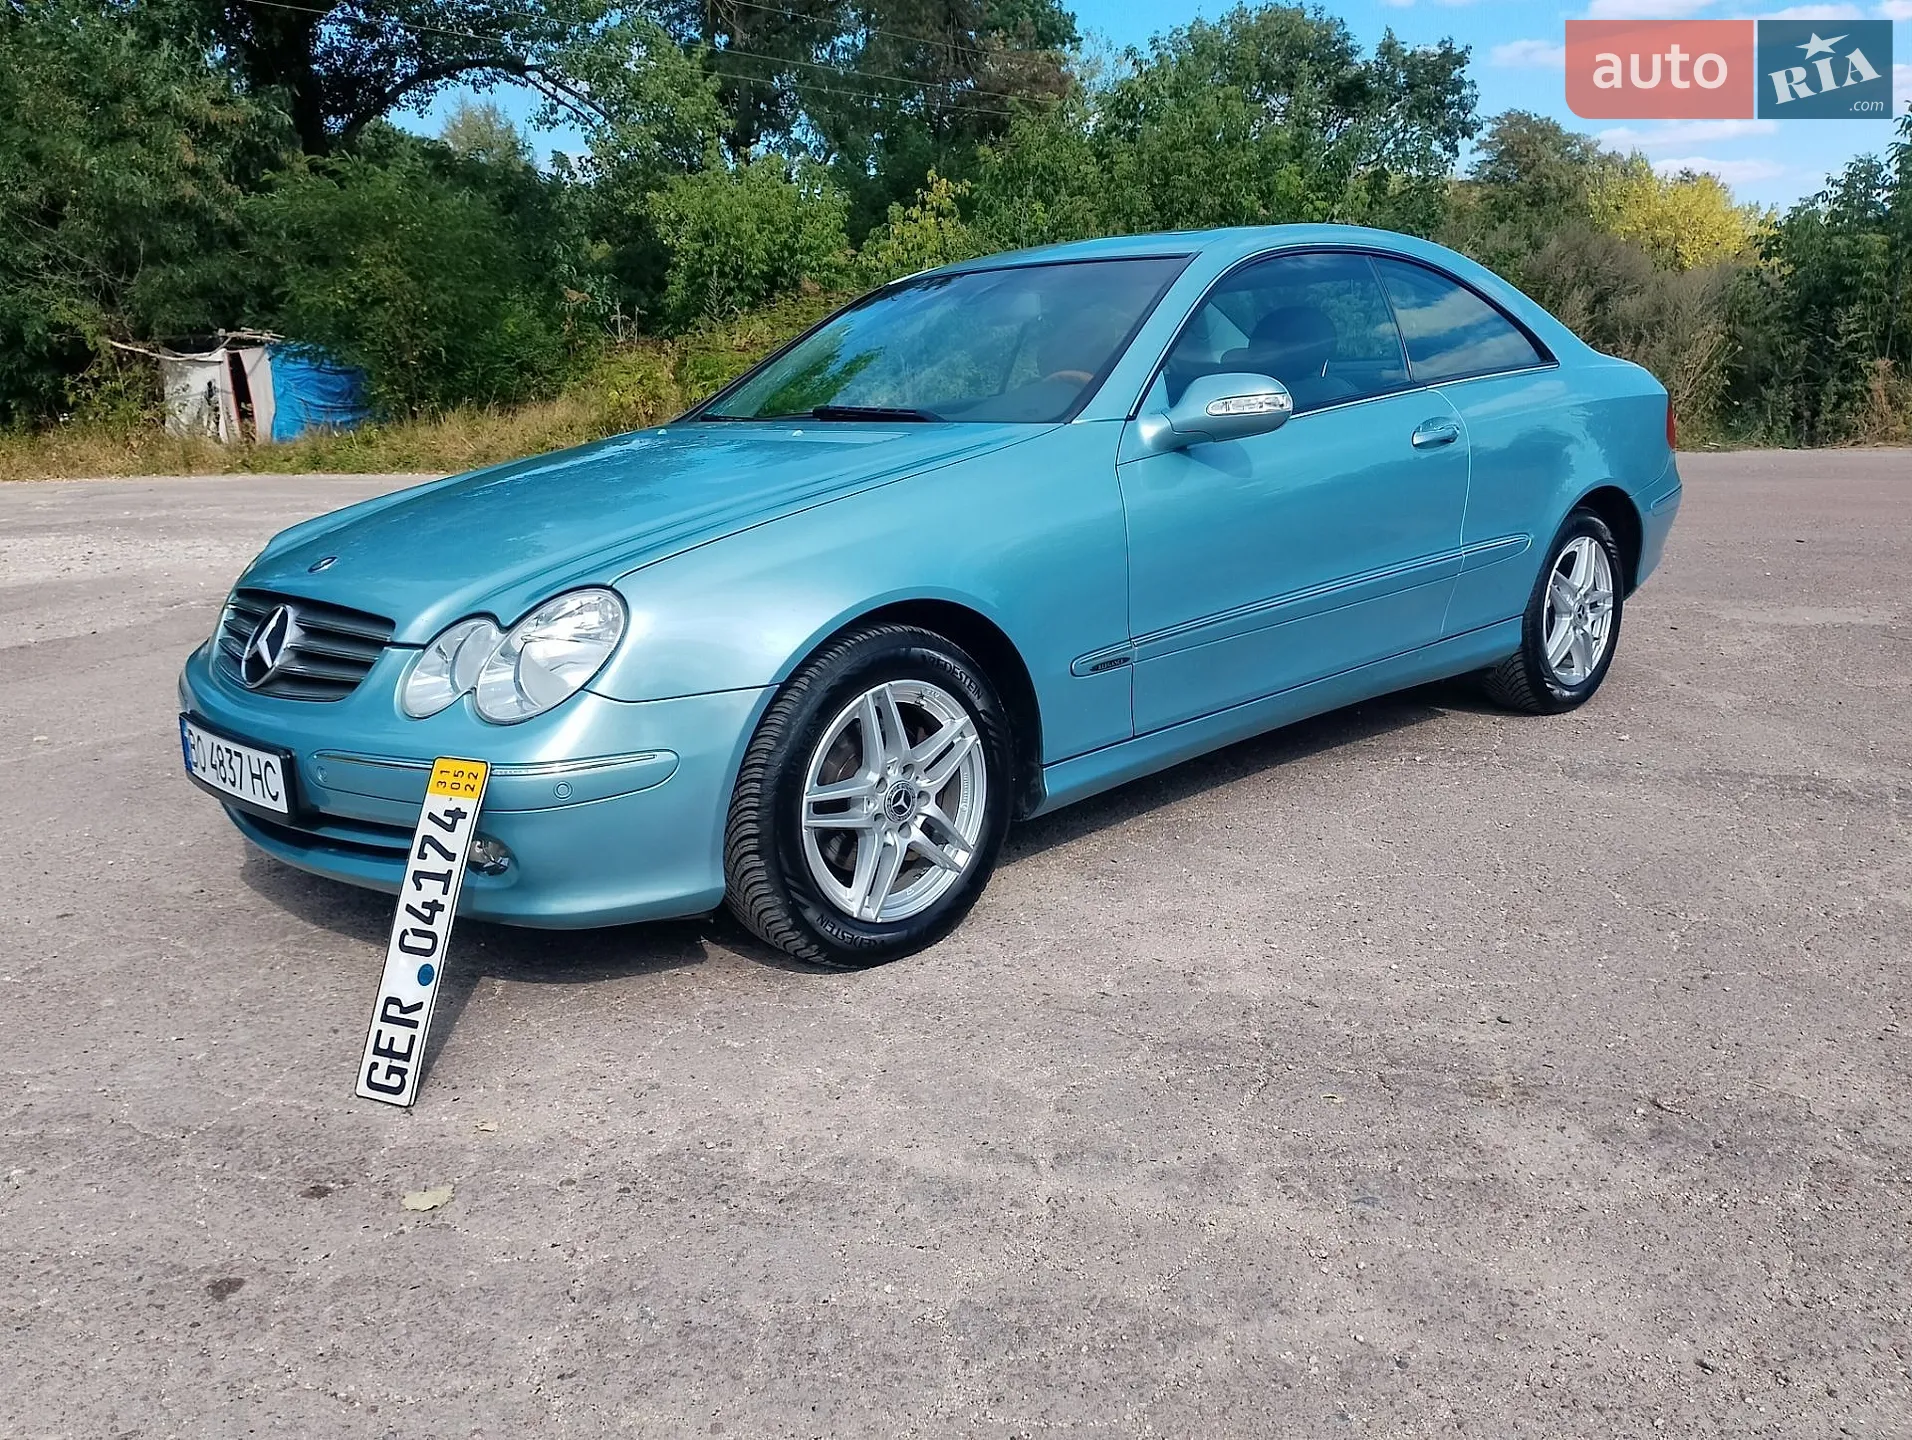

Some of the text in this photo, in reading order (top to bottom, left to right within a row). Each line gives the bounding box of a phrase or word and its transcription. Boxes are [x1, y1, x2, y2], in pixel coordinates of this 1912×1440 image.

[210, 742, 243, 791] 4837
[248, 755, 279, 802] HC
[437, 770, 450, 788] 31
[451, 770, 464, 790] 05
[465, 772, 478, 792] 22
[366, 807, 468, 1096] GER 04174
